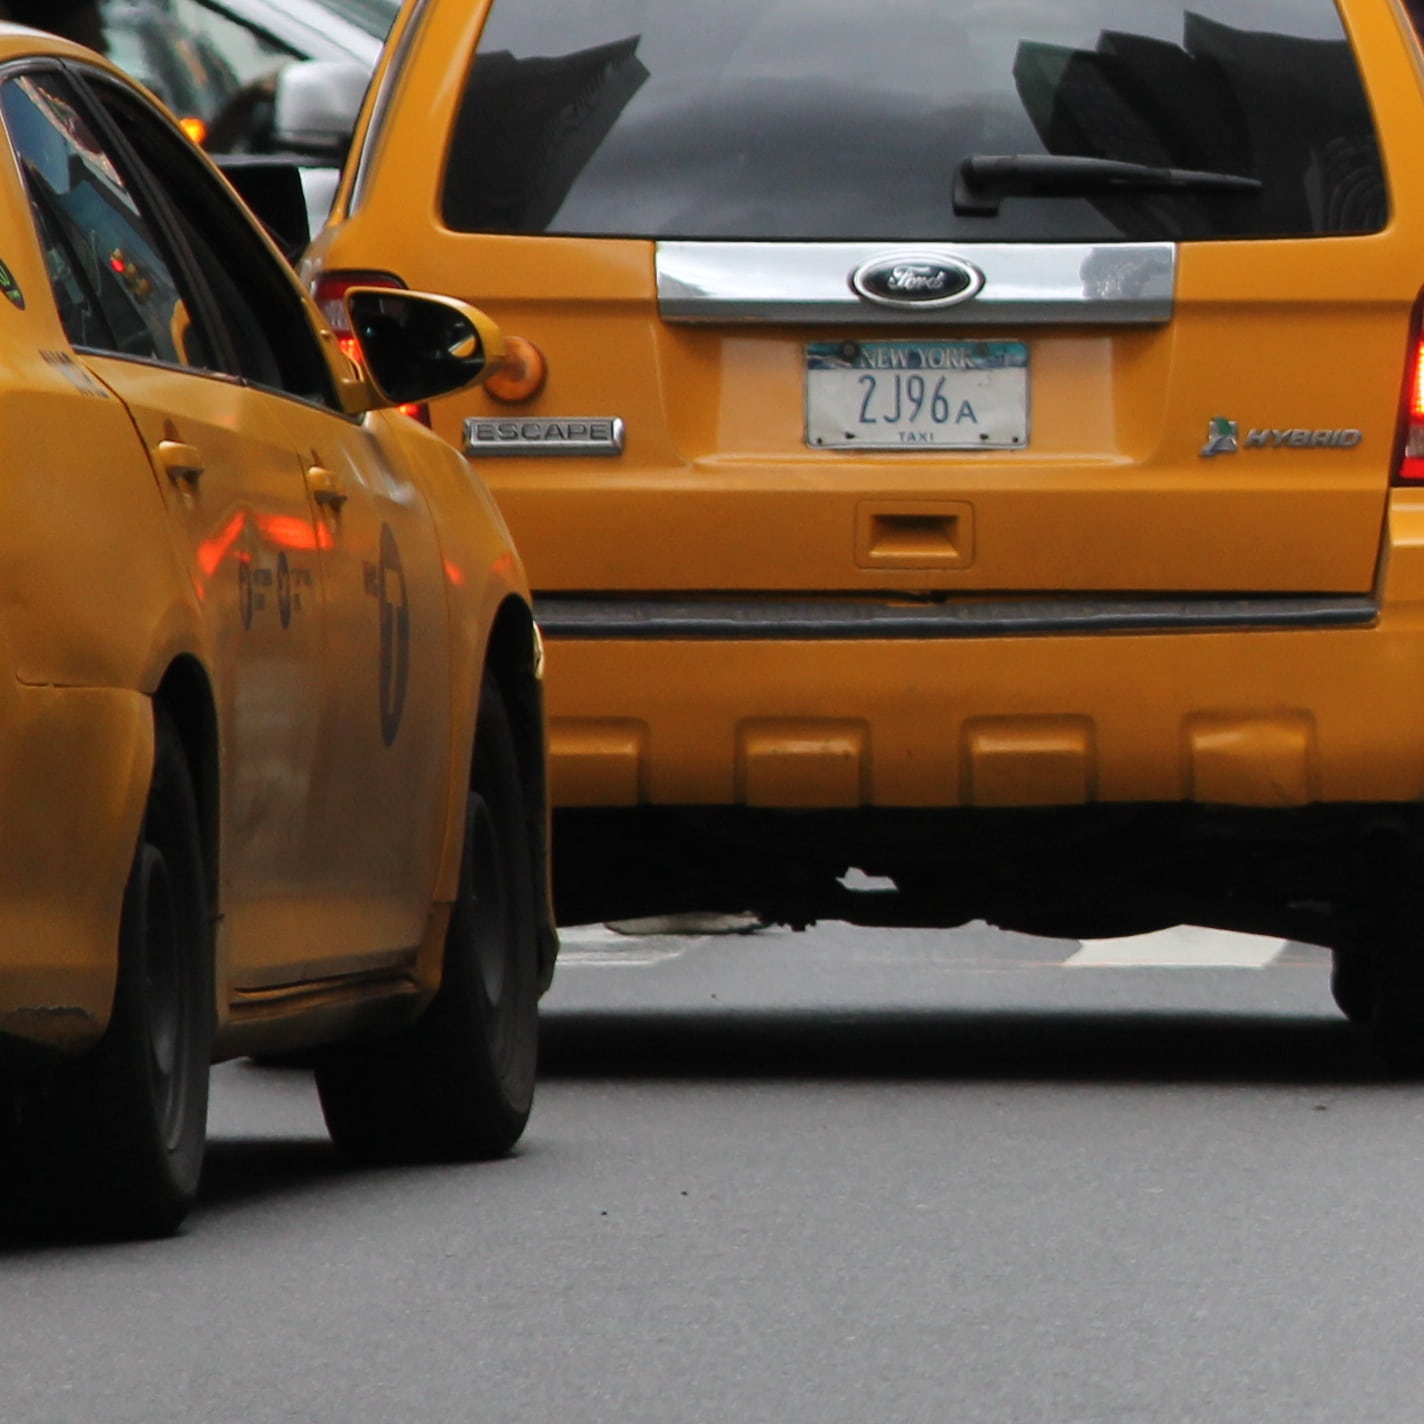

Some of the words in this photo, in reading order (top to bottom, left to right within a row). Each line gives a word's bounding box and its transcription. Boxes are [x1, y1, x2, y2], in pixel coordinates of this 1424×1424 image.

[888, 266, 946, 290] Ford
[860, 348, 911, 369] NEW
[918, 346, 975, 369] YORK
[857, 374, 978, 425] 2J96A
[476, 423, 608, 442] ESCAPE
[899, 431, 934, 442] TAXI
[1244, 428, 1364, 449] HYBRID
